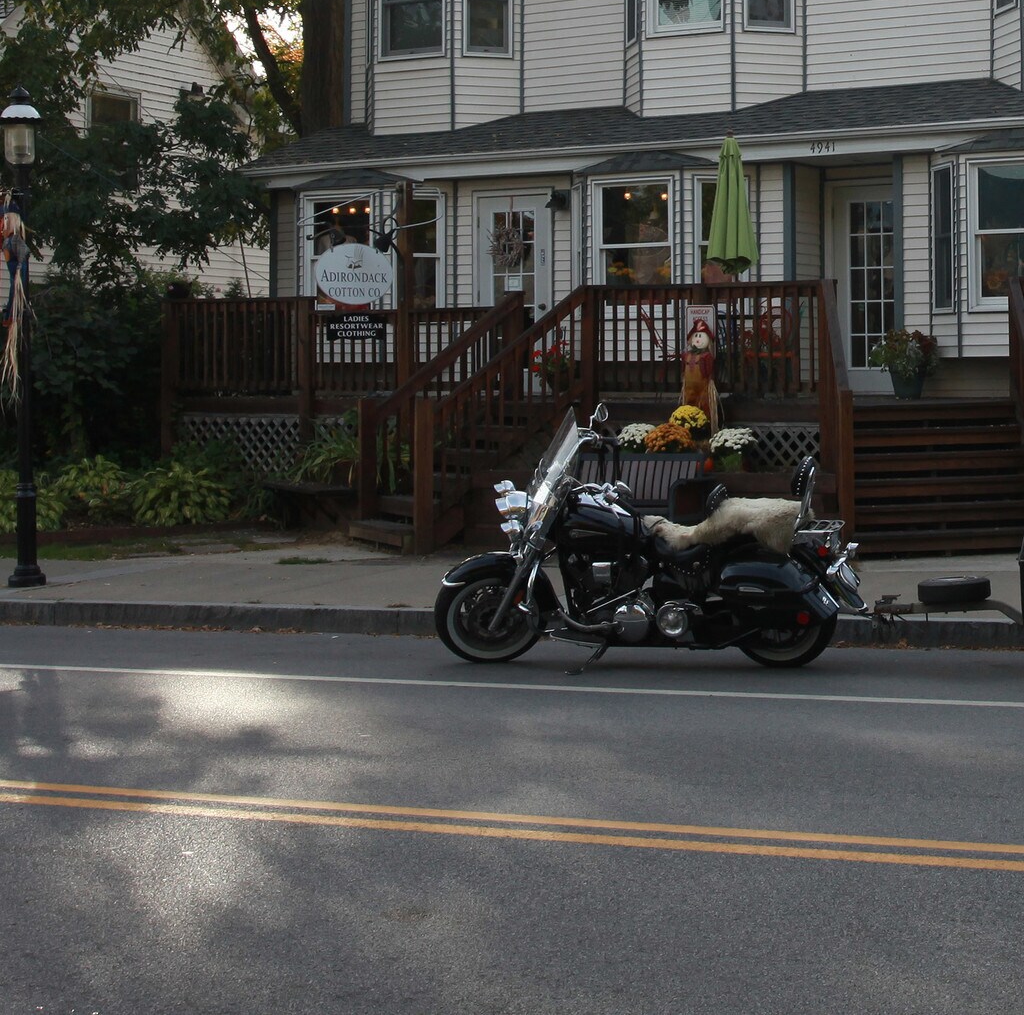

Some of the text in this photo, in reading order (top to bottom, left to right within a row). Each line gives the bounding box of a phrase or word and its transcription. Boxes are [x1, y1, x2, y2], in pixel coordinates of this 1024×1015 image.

[810, 141, 835, 154] 4941
[320, 269, 388, 283] ADIRONDACK
[328, 287, 365, 297] COTTON
